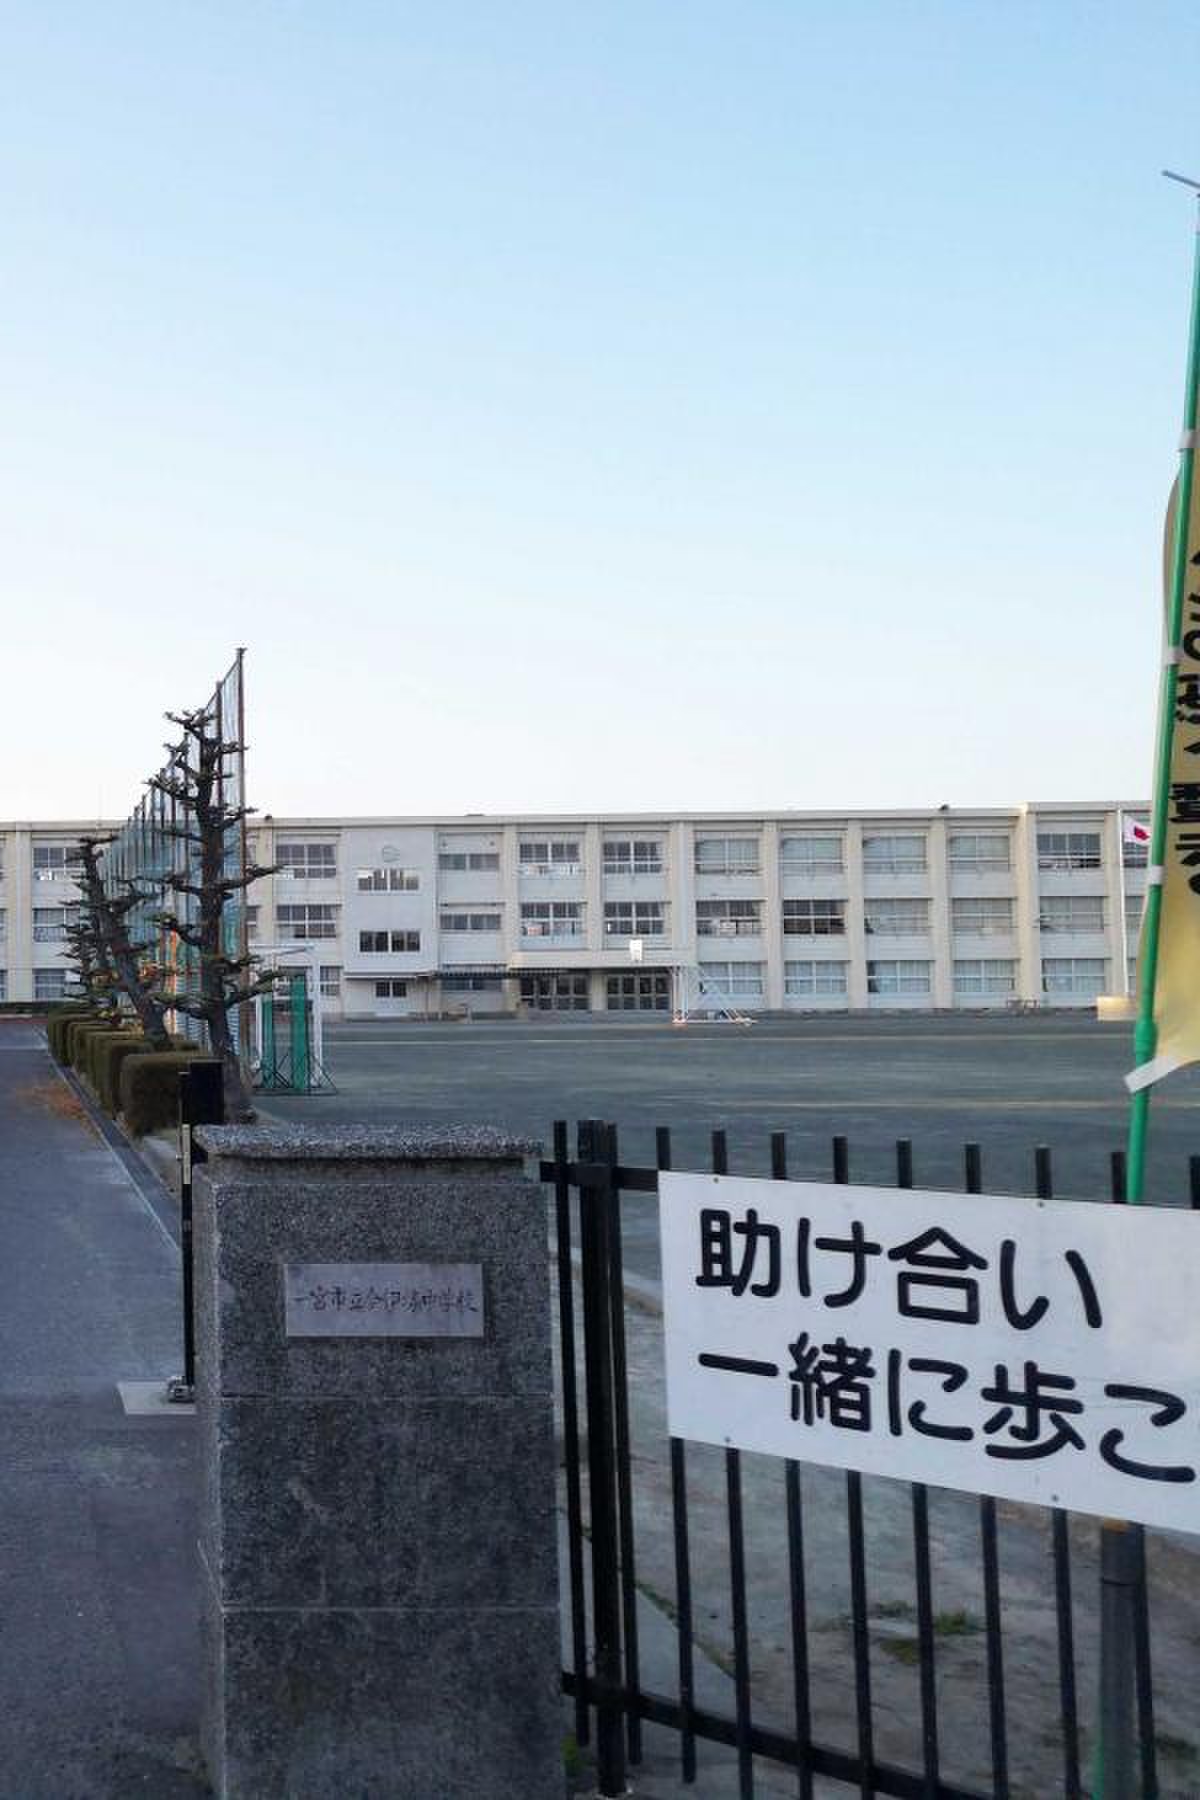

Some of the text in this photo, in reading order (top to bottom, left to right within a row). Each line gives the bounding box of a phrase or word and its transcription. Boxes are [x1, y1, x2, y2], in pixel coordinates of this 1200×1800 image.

[696, 1209, 1102, 1329] 助け合い
[698, 1332, 1196, 1482] 一緒に歩こ
